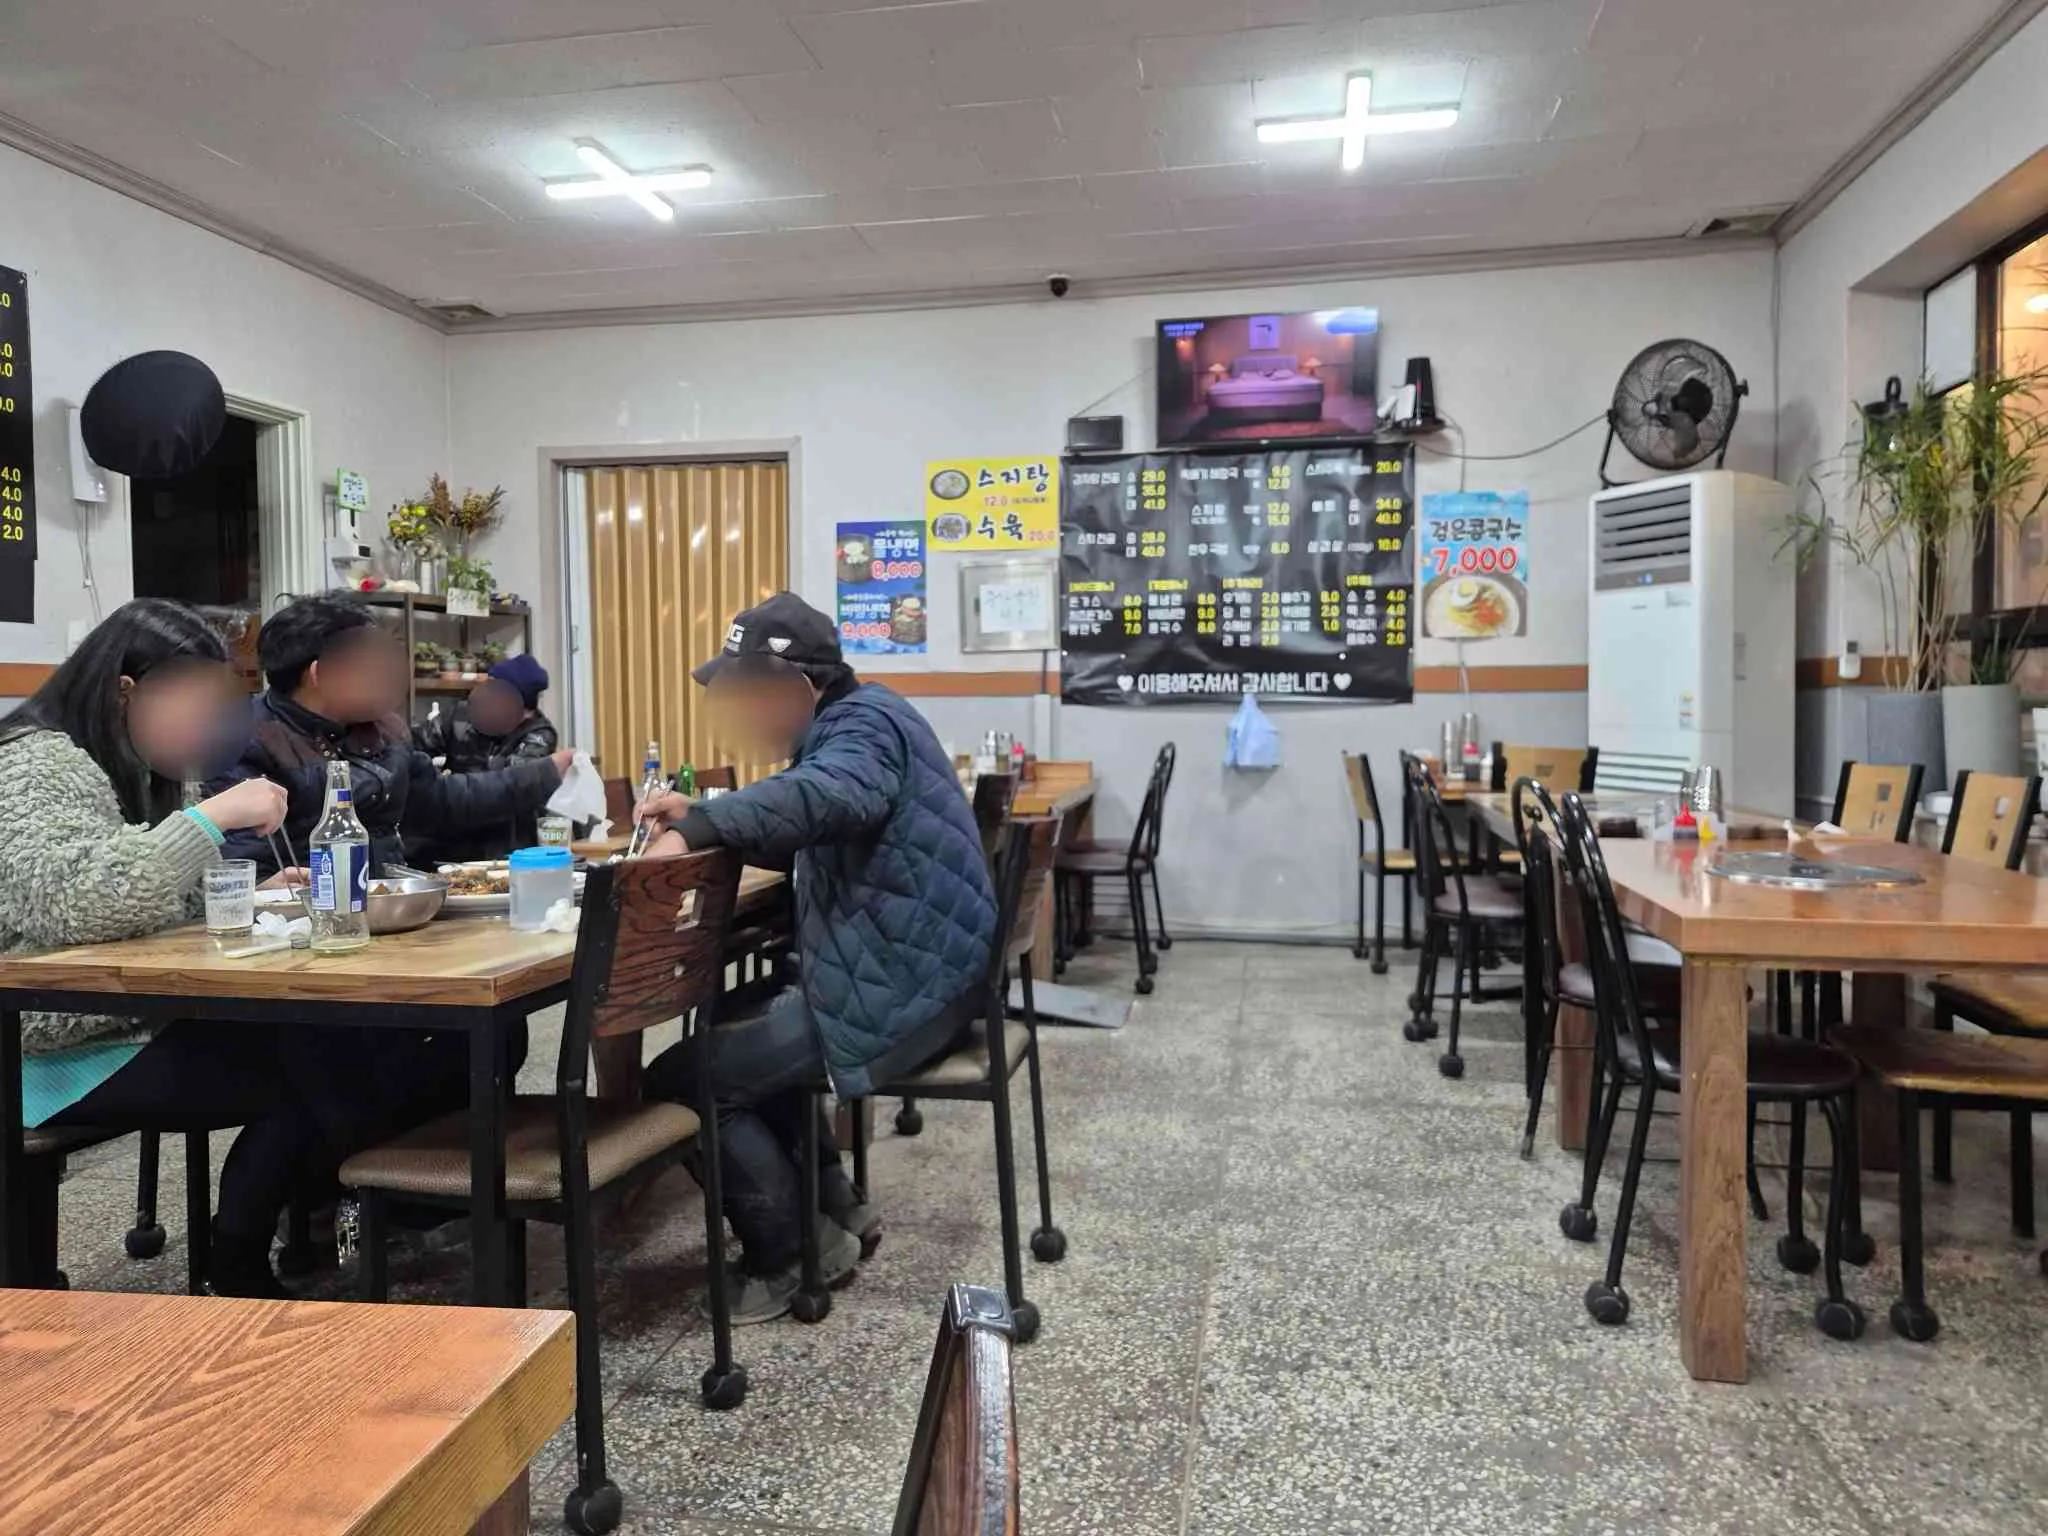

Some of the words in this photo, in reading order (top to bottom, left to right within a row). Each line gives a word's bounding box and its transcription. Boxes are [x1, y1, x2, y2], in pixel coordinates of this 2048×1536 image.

[1, 468, 21, 482] 4.0
[978, 464, 1050, 492] 스지탕
[1267, 478, 1291, 489] 12.0
[2, 487, 22, 502] 4.0
[984, 496, 1007, 507] 12.0
[2, 506, 23, 521] 4.0
[1267, 503, 1290, 514] 12.0
[3, 525, 24, 541] 2.0
[977, 514, 1024, 541] 수육
[1430, 518, 1521, 541] 검은콩국수
[873, 538, 919, 558] 물냉면
[1432, 547, 1518, 575] 7,000
[1386, 590, 1406, 602] 4.0
[1320, 605, 1340, 618] 2.0
[1386, 604, 1406, 616] 4.0
[1323, 619, 1340, 631] 1.0
[1386, 618, 1406, 631] 4.0
[1386, 633, 1406, 645] 2.0
[1138, 673, 1238, 693] 이용해주셔서
[1241, 672, 1329, 693] 감사합니다
